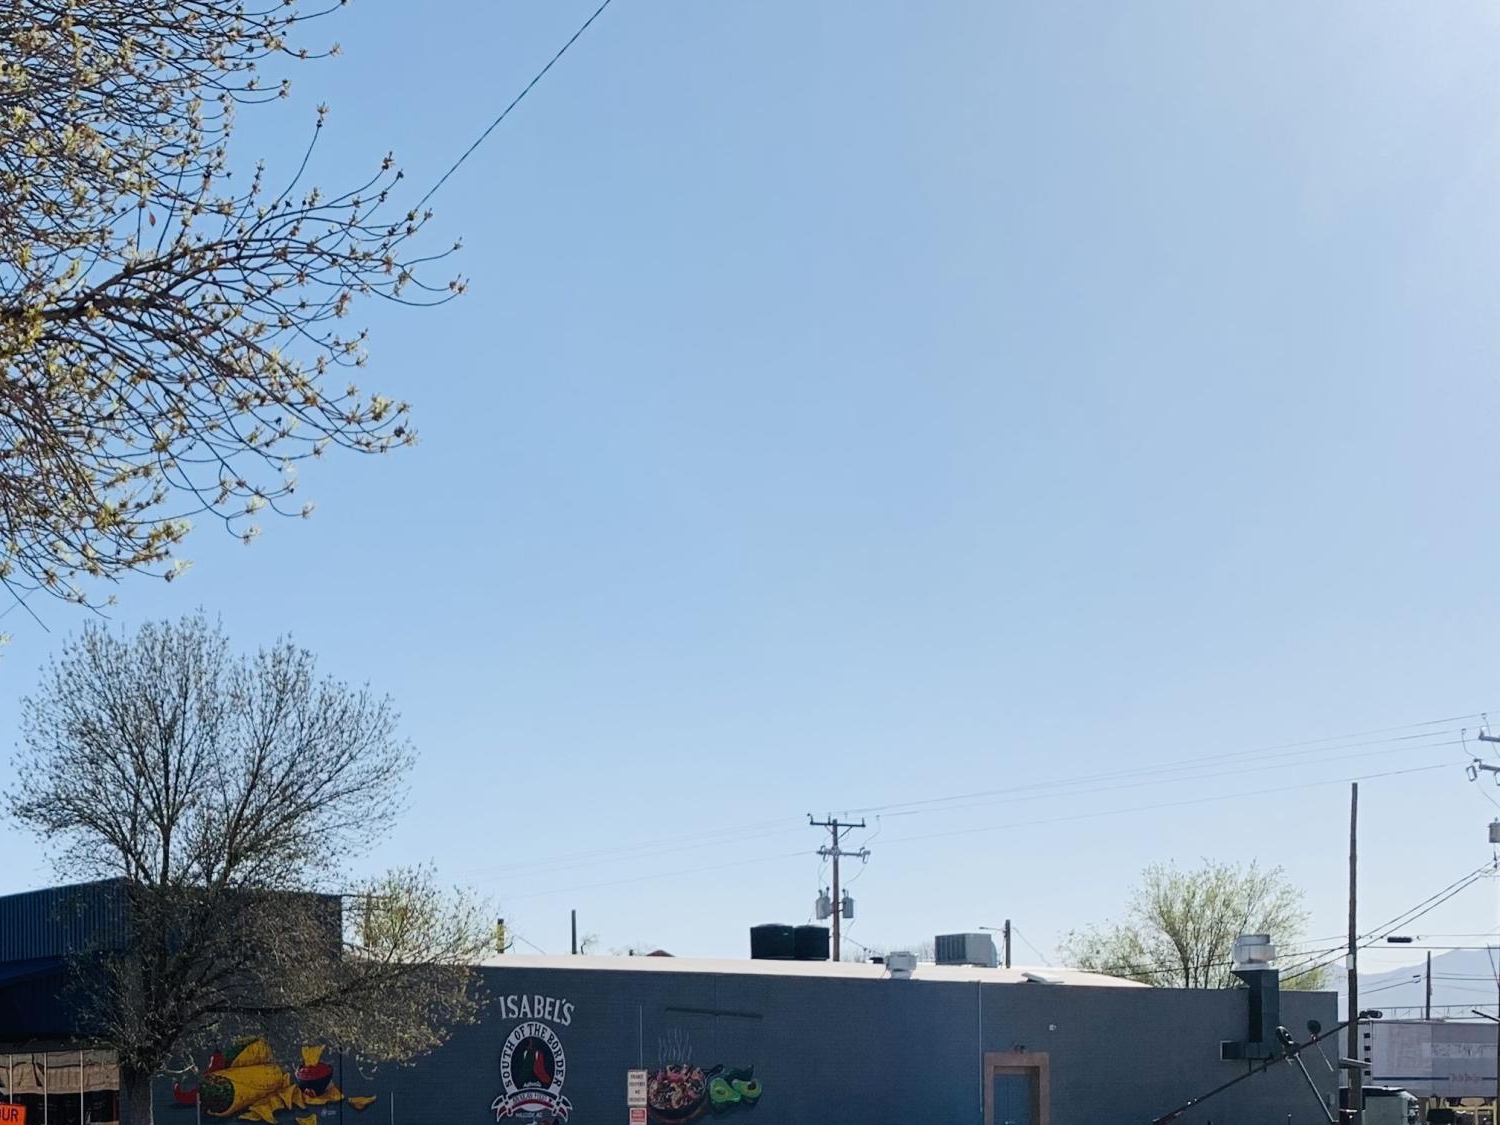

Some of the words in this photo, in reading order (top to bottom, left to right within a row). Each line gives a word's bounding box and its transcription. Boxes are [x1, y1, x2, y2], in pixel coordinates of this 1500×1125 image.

[499, 994, 575, 1026] ISABEL'S
[502, 1040, 515, 1087] SOUTH
[514, 1026, 525, 1040] OF
[527, 1023, 548, 1039] THE
[547, 1033, 564, 1087] BORDER
